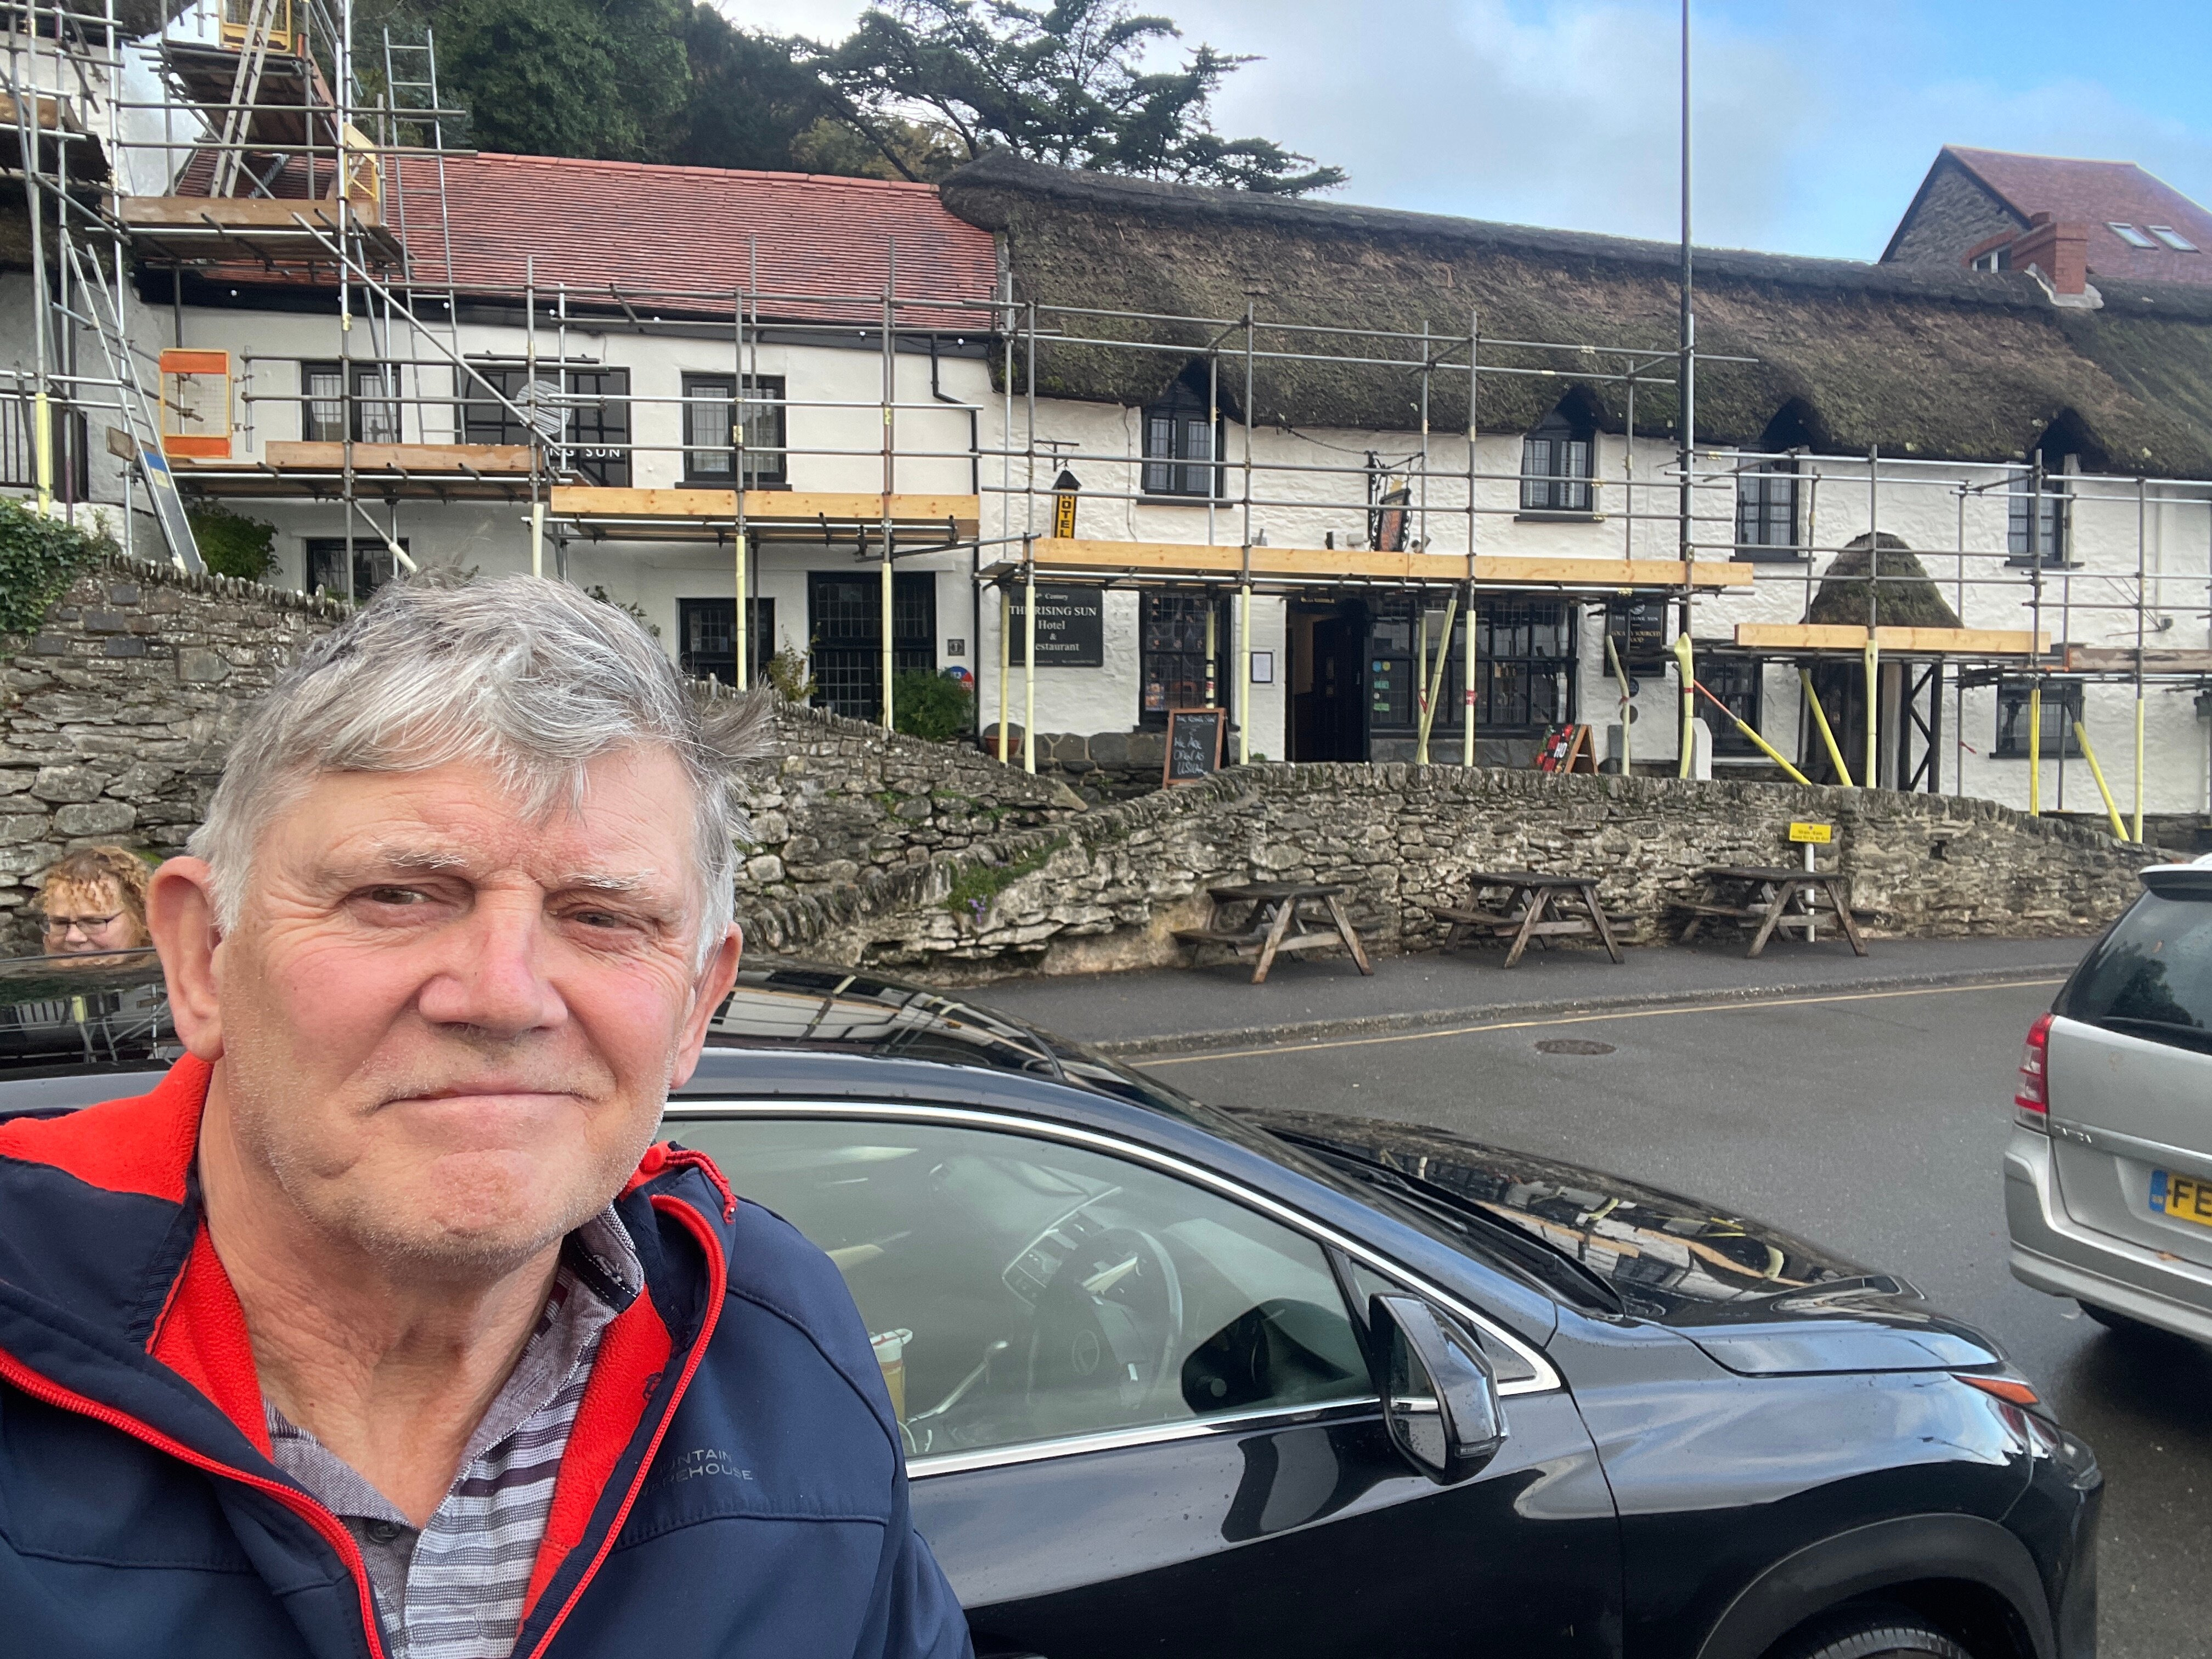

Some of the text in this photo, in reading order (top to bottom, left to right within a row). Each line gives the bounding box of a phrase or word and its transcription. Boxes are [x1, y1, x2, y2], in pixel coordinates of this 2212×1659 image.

[586, 448, 620, 457] SUN
[1009, 606, 1097, 616] TH RISING SUN
[1038, 620, 1065, 630] Hotel
